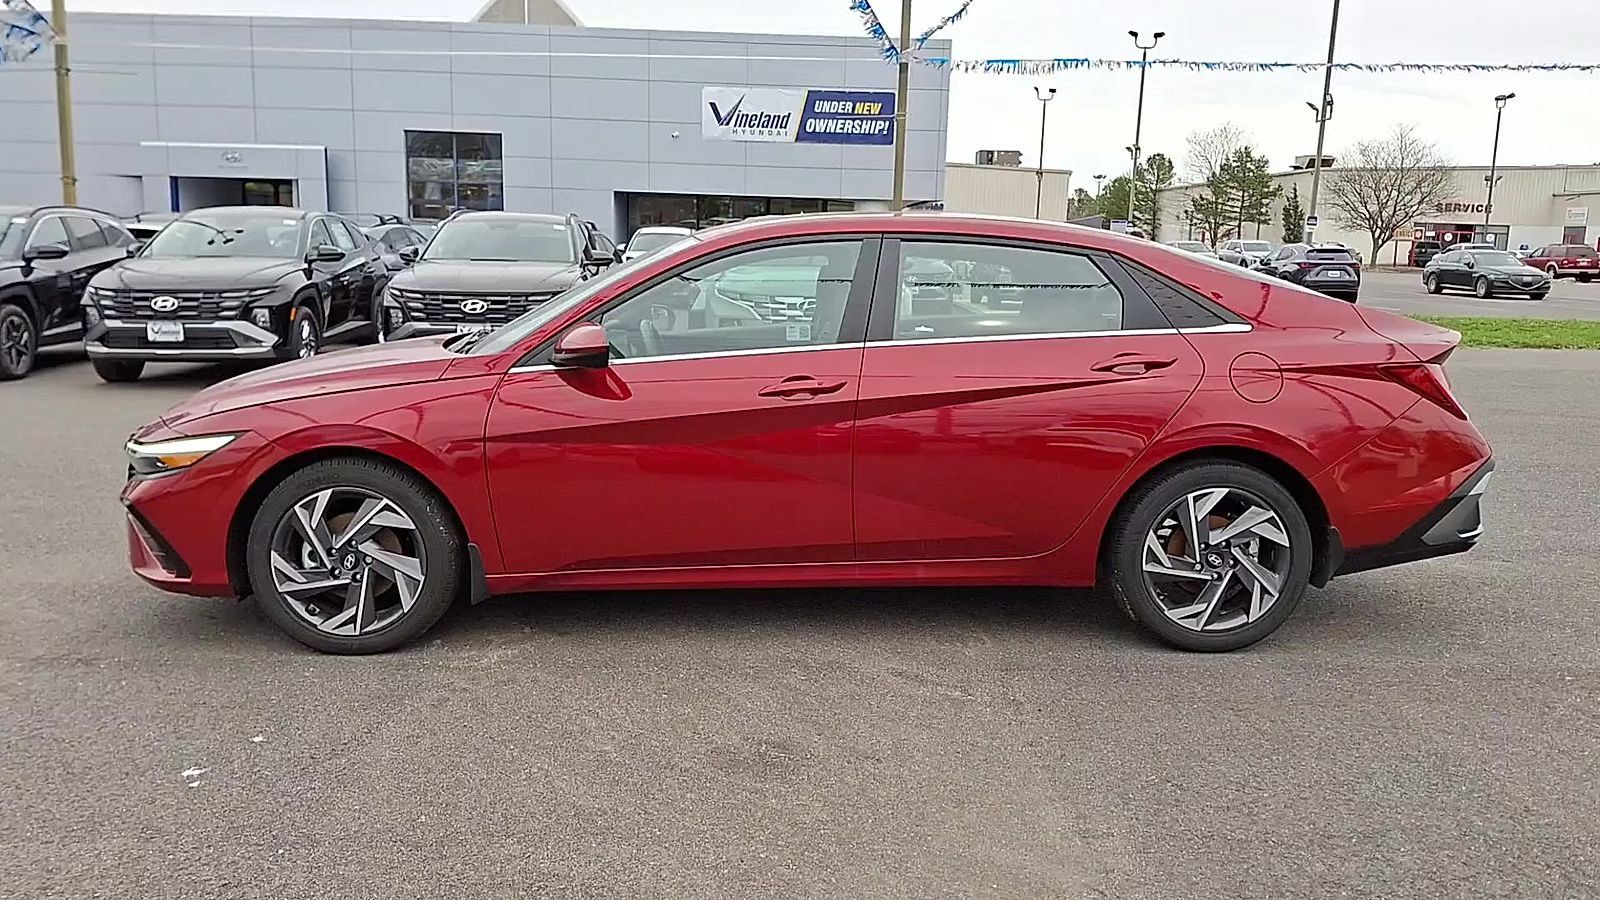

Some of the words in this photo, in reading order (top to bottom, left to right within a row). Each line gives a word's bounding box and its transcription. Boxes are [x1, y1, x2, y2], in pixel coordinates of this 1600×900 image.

[709, 93, 792, 130] Vineland
[814, 100, 853, 114] UNDER
[854, 102, 882, 115] NEW
[732, 128, 788, 137] HYUNDAI
[805, 118, 890, 135] OWNERSHIP!
[1435, 203, 1493, 214] SERVICE
